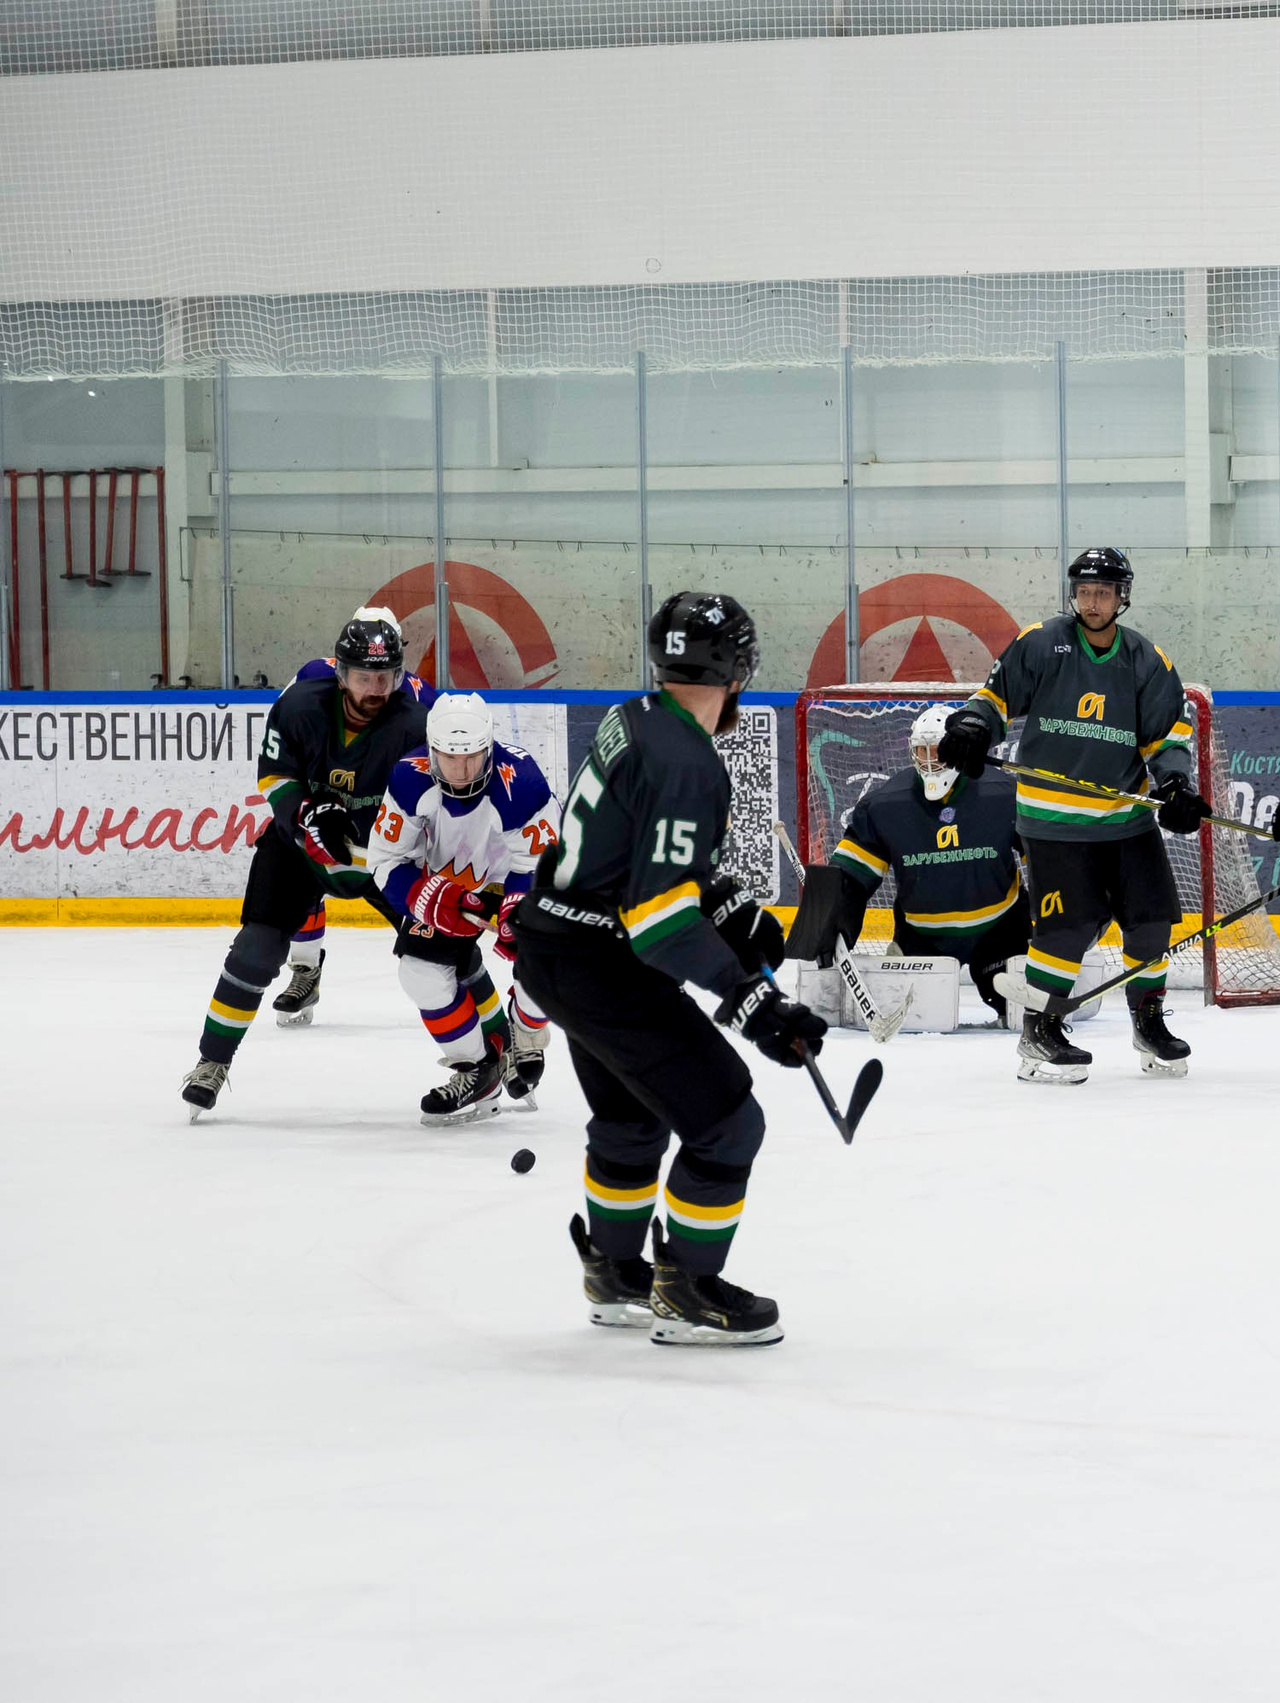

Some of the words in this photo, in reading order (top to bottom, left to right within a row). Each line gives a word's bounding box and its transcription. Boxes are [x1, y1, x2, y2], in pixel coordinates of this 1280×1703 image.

[368, 642, 386, 655] 25
[665, 631, 687, 655] 15
[260, 728, 282, 761] 5
[1038, 717, 1138, 747] ЗАРУБЕЖНЕФТЬ
[374, 803, 404, 843] 23
[522, 818, 559, 856] 23
[651, 818, 698, 866] 15
[902, 846, 999, 867] ЗАРУБЕЖНЕФТЬ
[537, 897, 615, 930] BAUER
[712, 889, 753, 927] AUE
[1161, 933, 1204, 963] ALPHA
[1206, 922, 1223, 938] LX
[880, 961, 934, 972] BAUER
[730, 980, 774, 1032] UER
[840, 958, 876, 1022] BAUER
